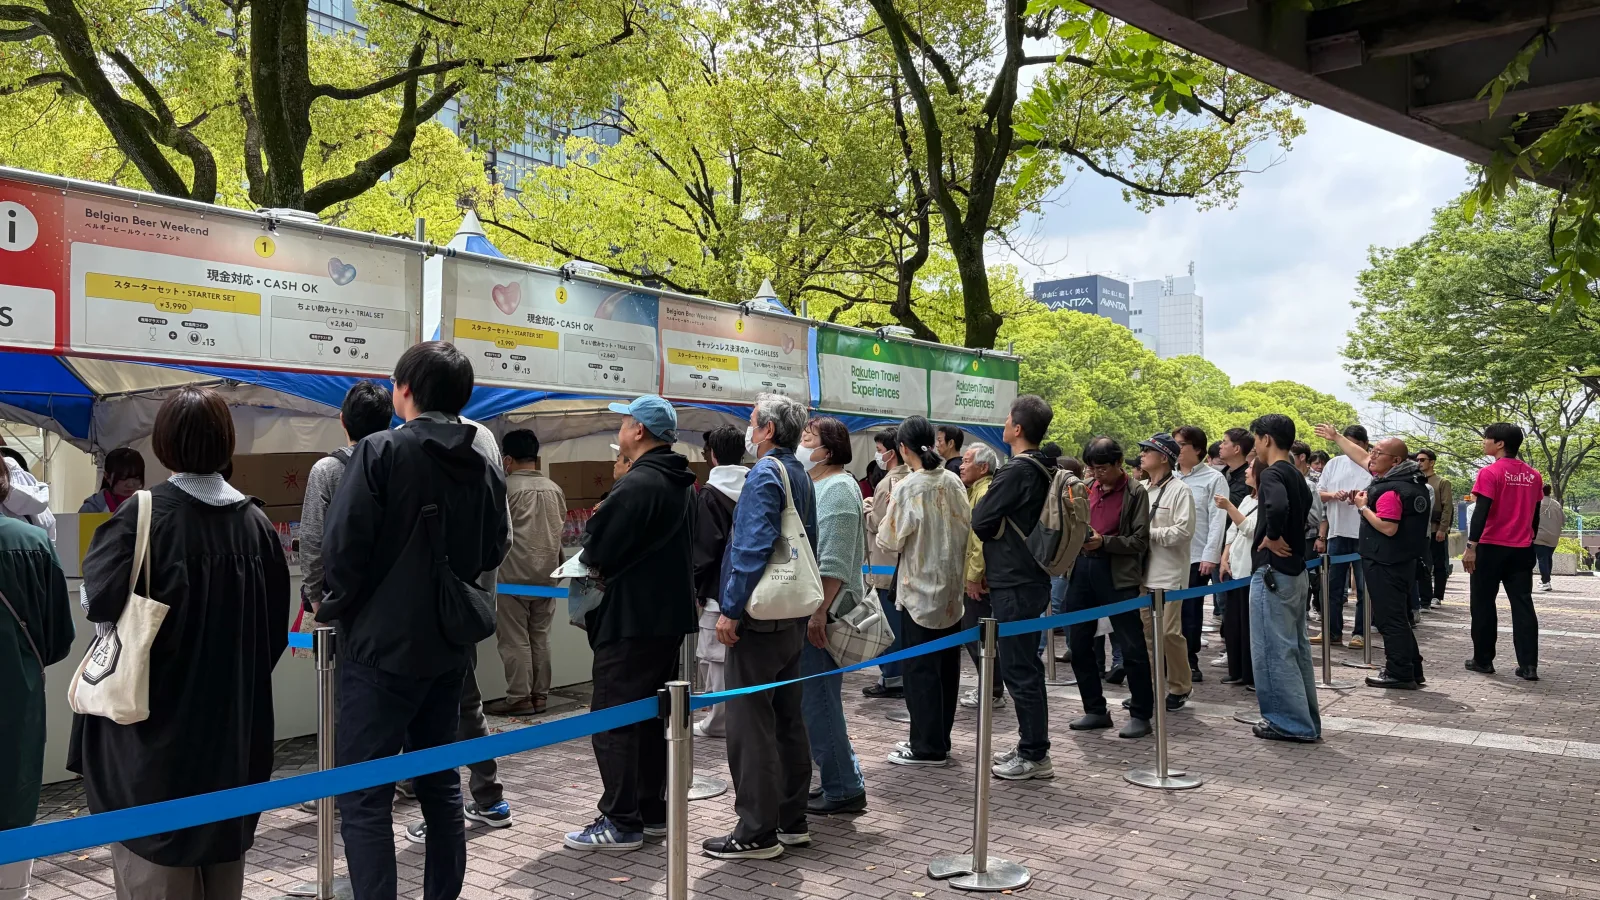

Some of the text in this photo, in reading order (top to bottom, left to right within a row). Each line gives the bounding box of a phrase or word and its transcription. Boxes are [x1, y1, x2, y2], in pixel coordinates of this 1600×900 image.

[85, 208, 209, 236] Belgian Beer Weekend
[85, 223, 181, 242] ベルギービールウィークエンド
[261, 241, 267, 252] 1
[301, 283, 318, 293] OK
[559, 291, 564, 300] 2
[159, 301, 187, 311] ¥3,990
[1100, 298, 1128, 312] AVANTIA
[666, 307, 717, 322] Belgian Beer Weekend
[330, 320, 353, 328] ¥2,840
[583, 323, 594, 331] OK
[738, 322, 742, 330] 3
[851, 365, 900, 383] Rakuten Travel
[851, 381, 900, 400] Experiences
[955, 380, 995, 395] Rakuten Travel
[954, 395, 995, 409] Experiences
